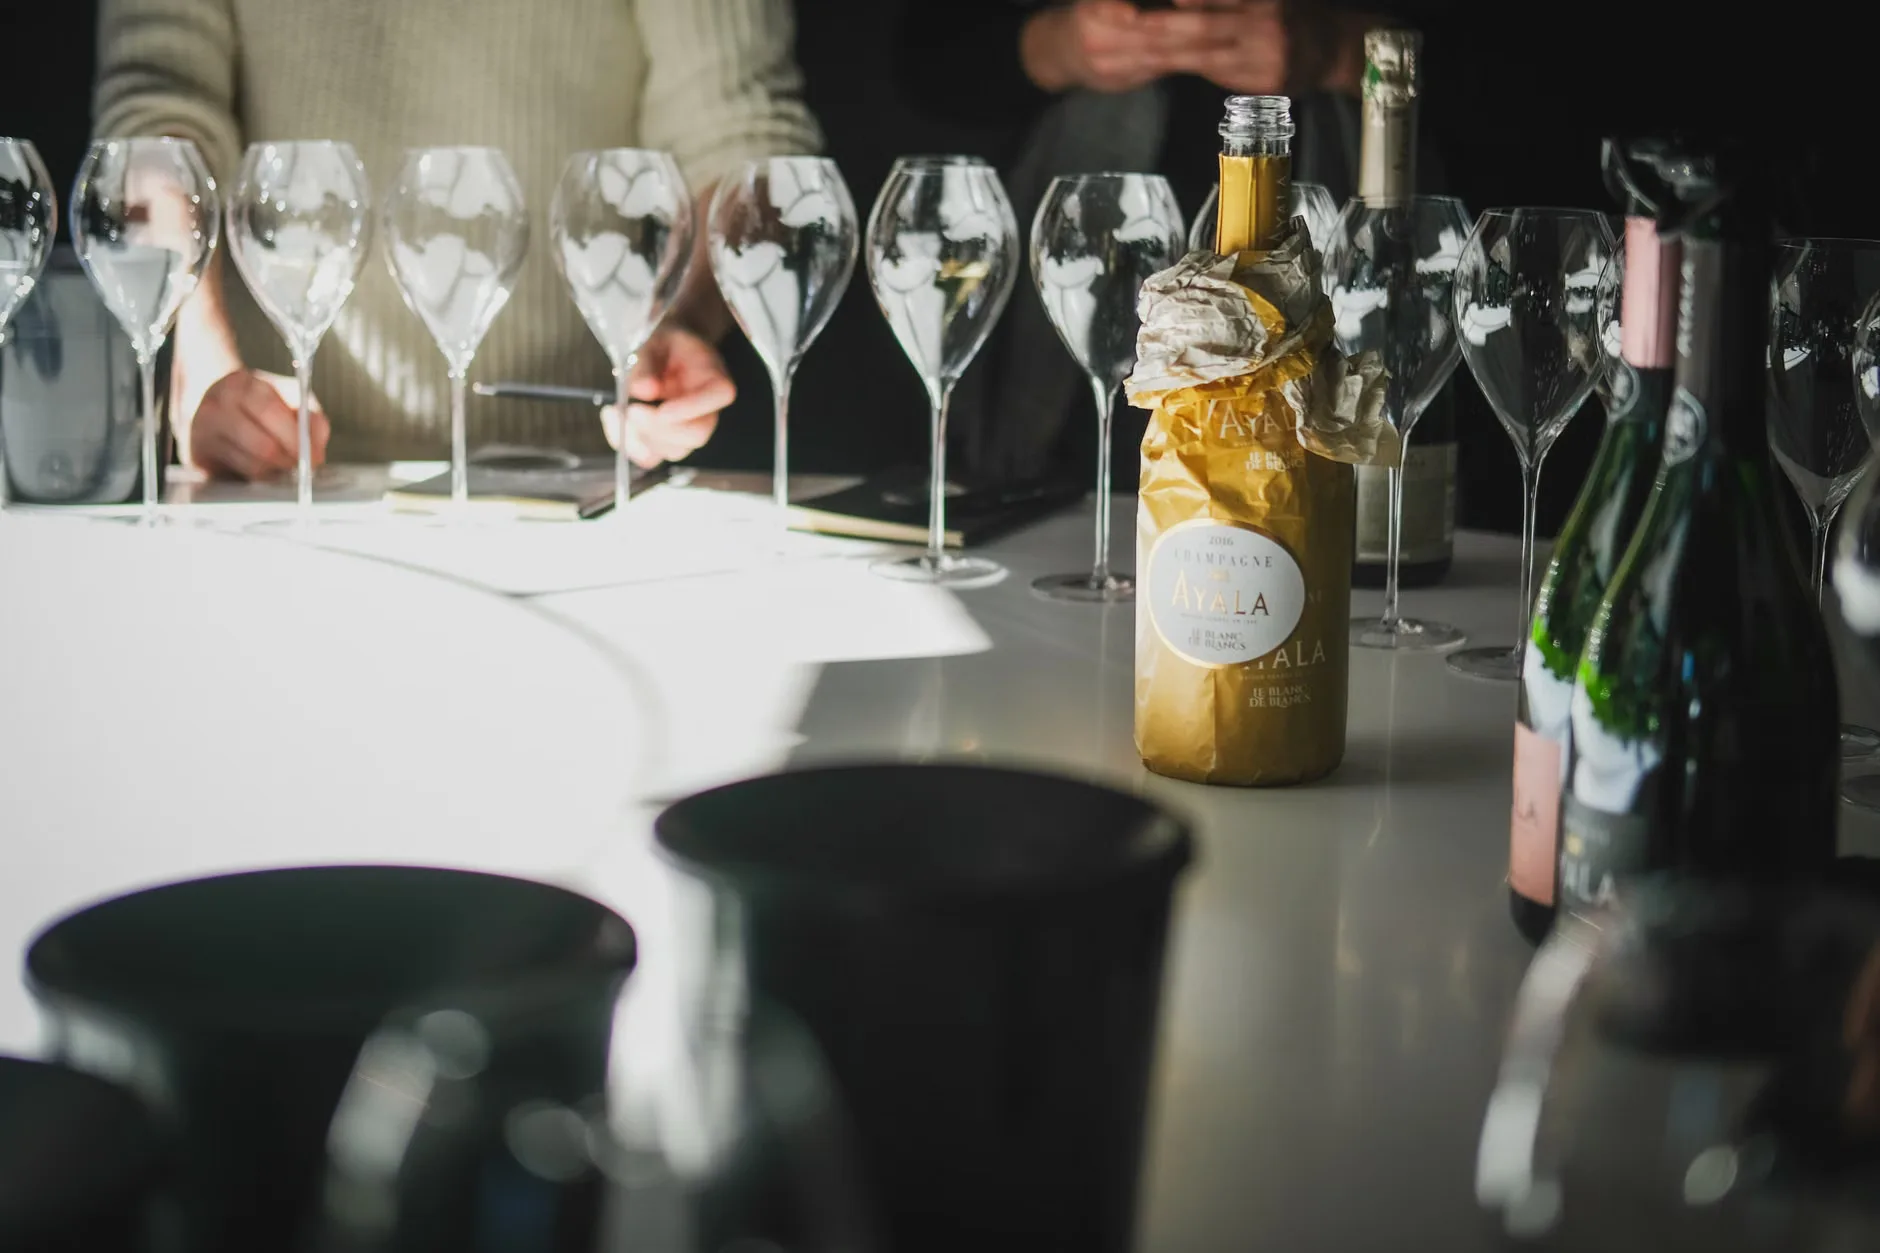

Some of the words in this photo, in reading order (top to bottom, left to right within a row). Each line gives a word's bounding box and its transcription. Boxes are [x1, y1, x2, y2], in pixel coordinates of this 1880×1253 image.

[1218, 398, 1298, 439] AYAL
[1207, 535, 1235, 547] 2016
[1173, 547, 1274, 569] CHAMPAGNE
[1171, 569, 1271, 617] AYALA
[1204, 629, 1243, 641] BLANC
[1204, 638, 1247, 652] BLANCS
[1243, 639, 1327, 670] ALA
[1252, 687, 1266, 698] LE
[1267, 684, 1312, 697] BLANC
[1248, 696, 1266, 708] DE
[1268, 694, 1312, 709] BLANCS
